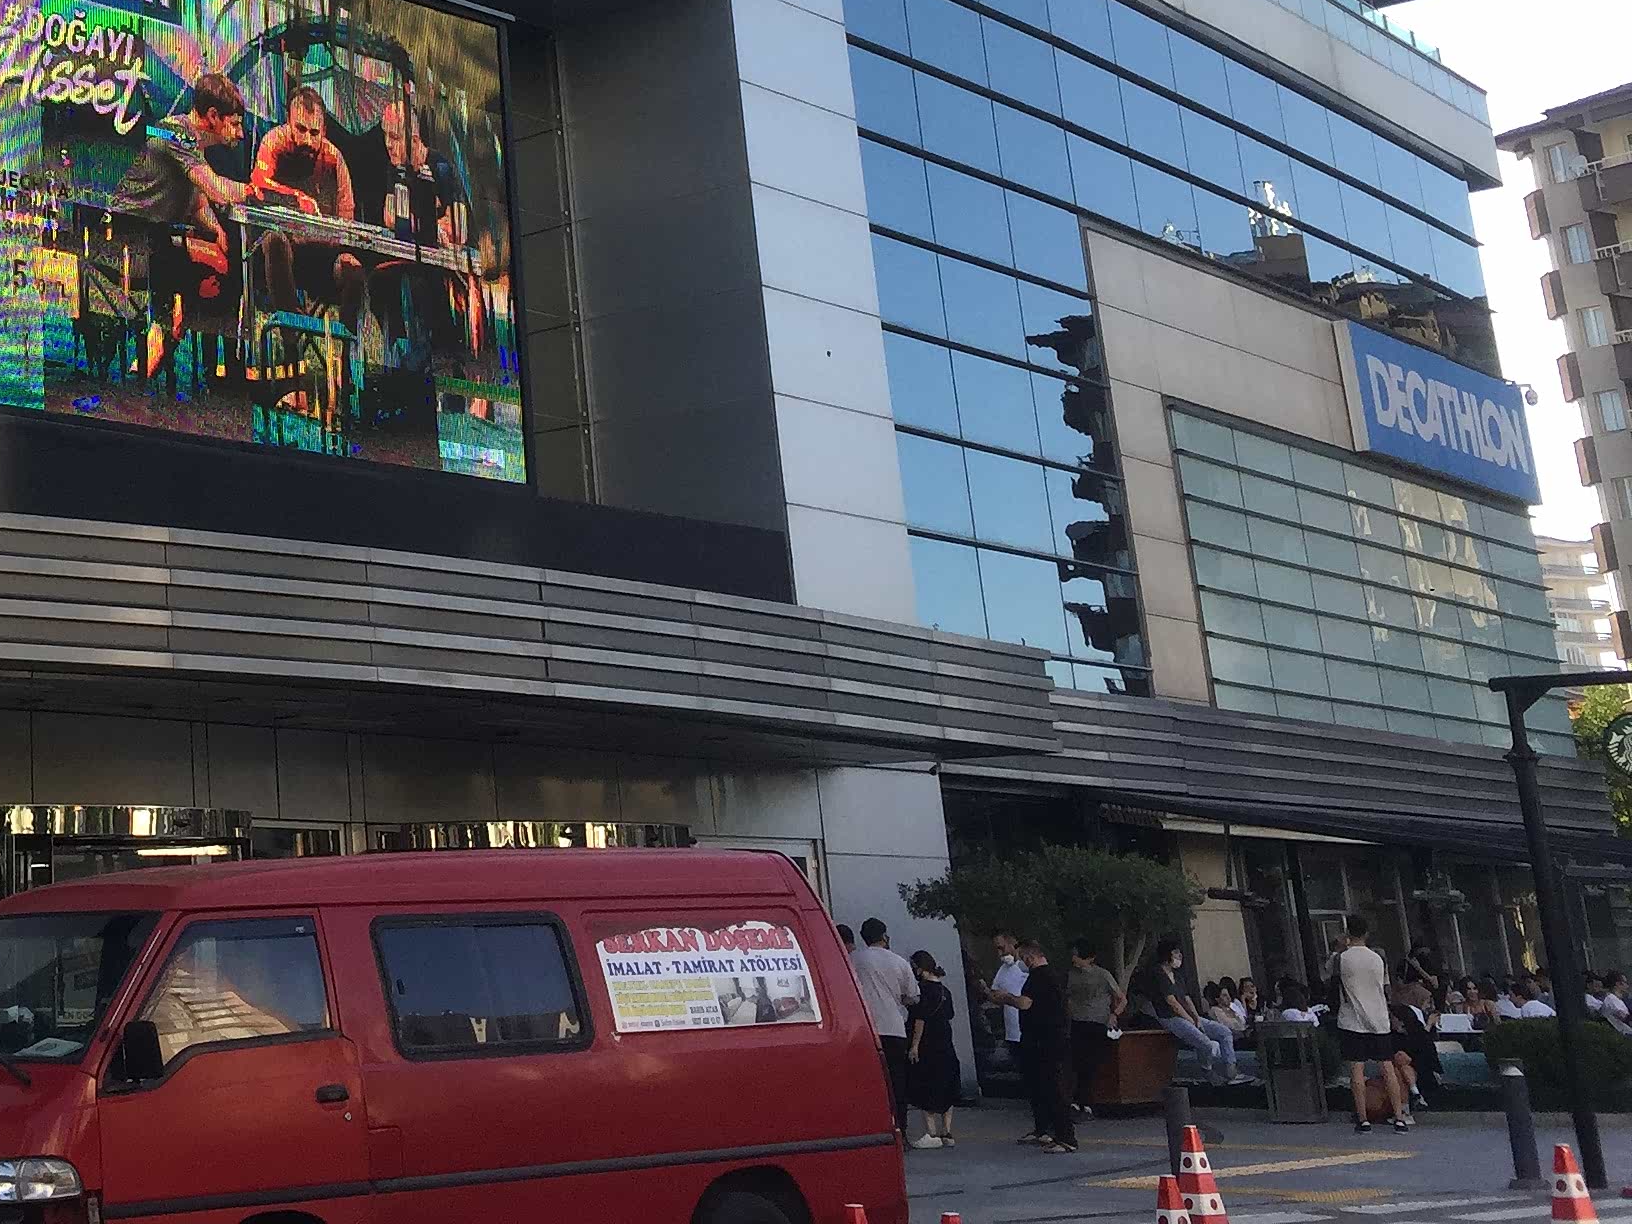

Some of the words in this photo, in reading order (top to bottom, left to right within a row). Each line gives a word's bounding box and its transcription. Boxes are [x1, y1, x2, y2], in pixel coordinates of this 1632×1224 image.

[1366, 354, 1530, 475] DECATHLON
[606, 958, 662, 976] İMALAT
[672, 956, 735, 974] TAMİRAT
[740, 954, 804, 972] ATÖLYESİ
